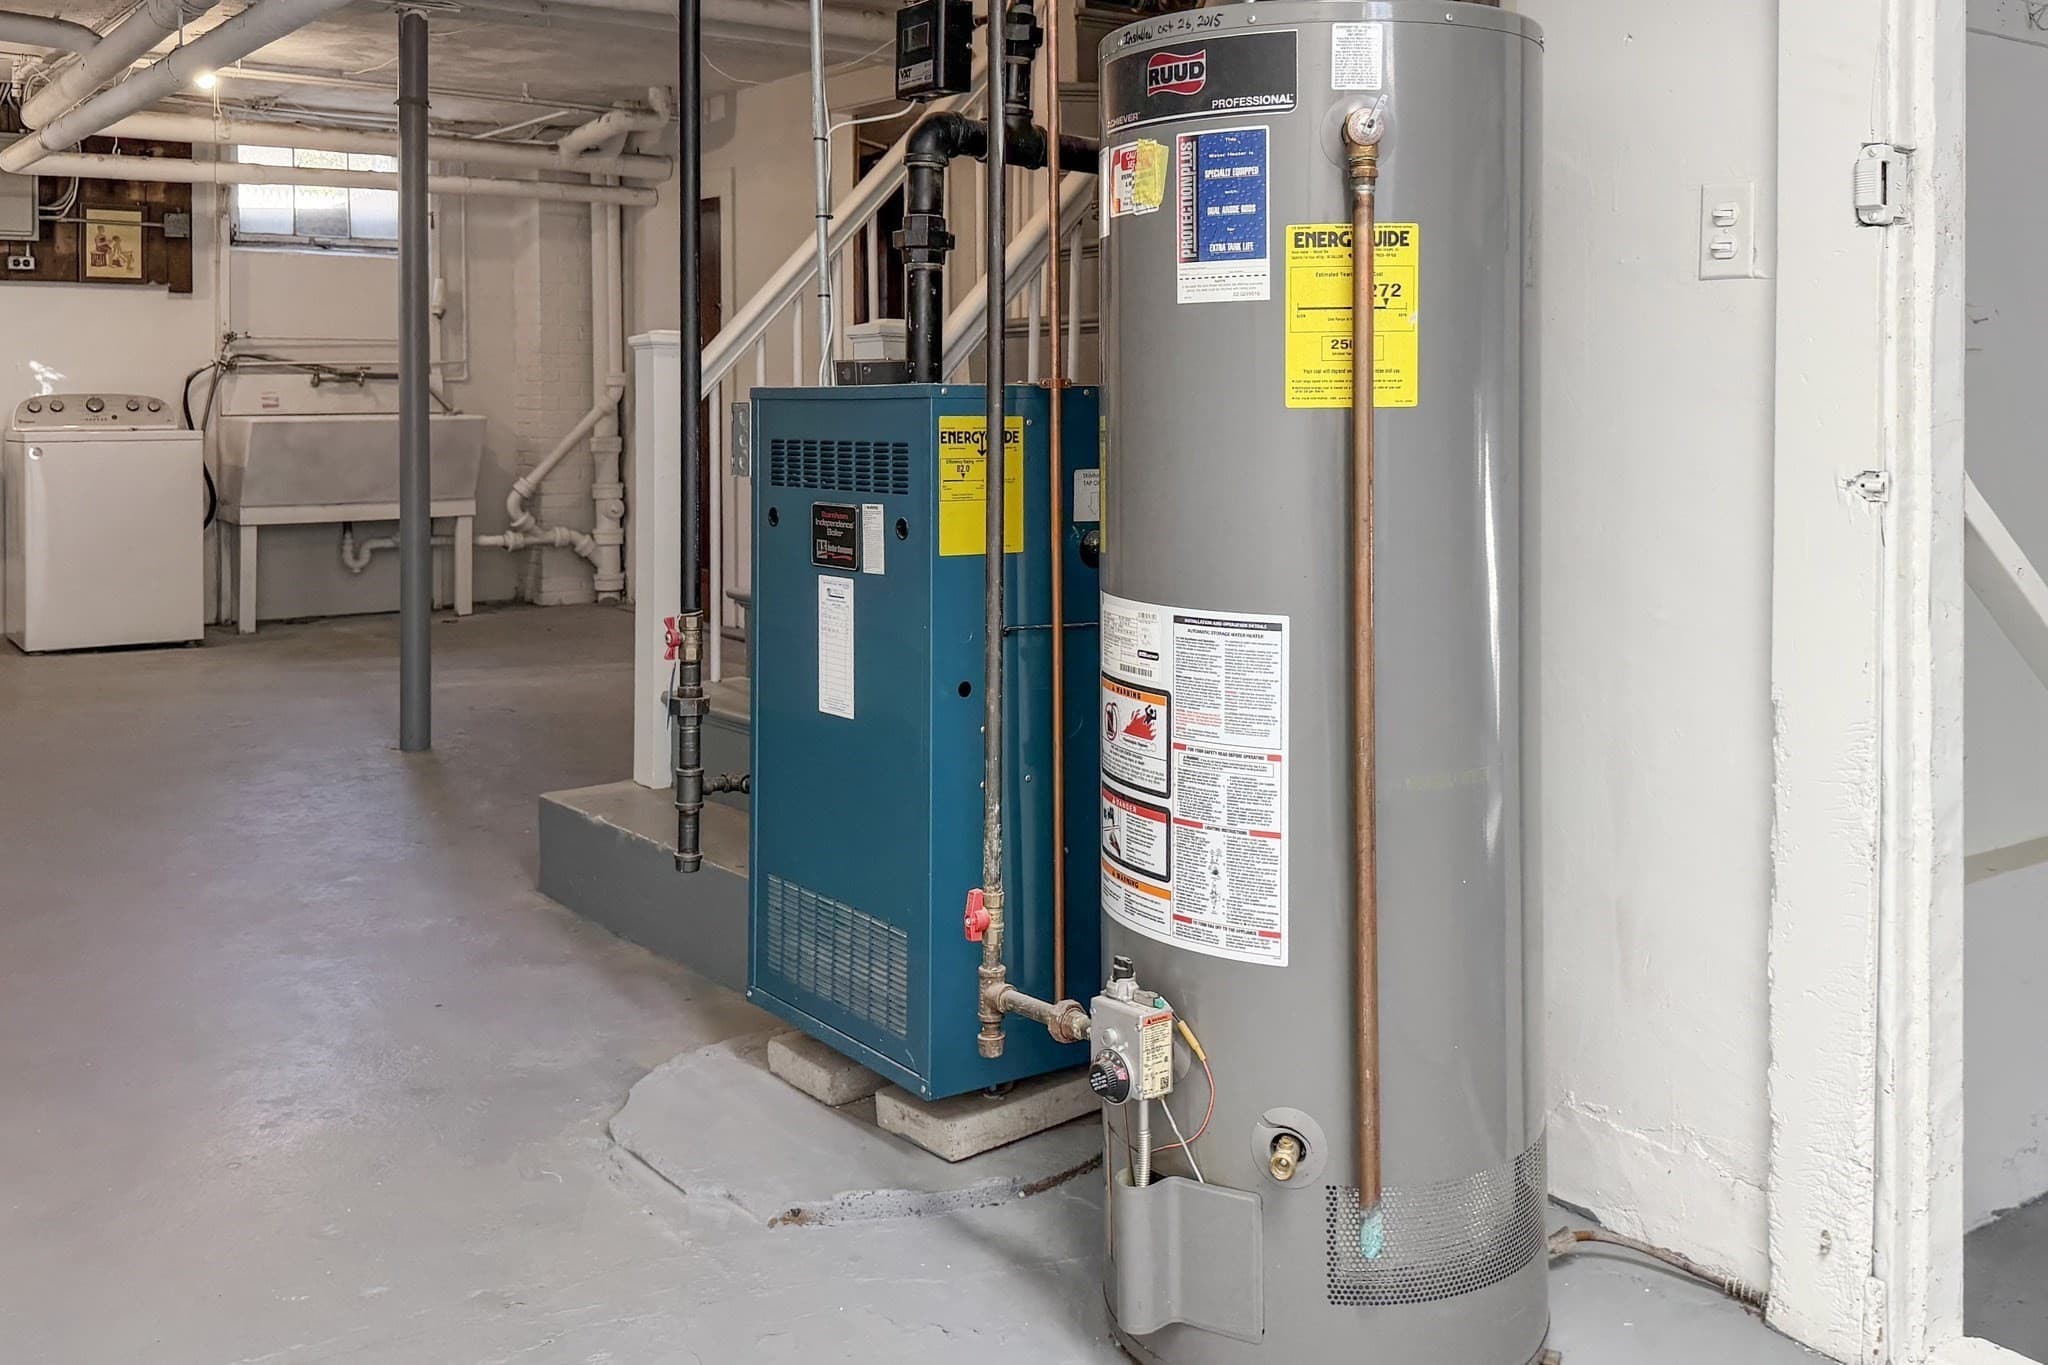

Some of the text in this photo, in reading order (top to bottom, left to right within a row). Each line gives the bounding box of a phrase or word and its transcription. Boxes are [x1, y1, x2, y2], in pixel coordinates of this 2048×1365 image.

[1197, 13, 1224, 27] 2015
[900, 68, 912, 80] VXT
[1149, 61, 1205, 87] RUUD
[1211, 94, 1294, 109] PROFESSIONAL
[1204, 165, 1259, 179] SPECIALLY EQUIPPED
[1207, 206, 1220, 216] DUAL
[1294, 230, 1410, 248] ENERGUIDE
[1209, 243, 1225, 252] EXTRA
[1243, 241, 1255, 251] LIFE
[1331, 339, 1352, 350] 25
[940, 430, 1020, 445] ENERGYDE
